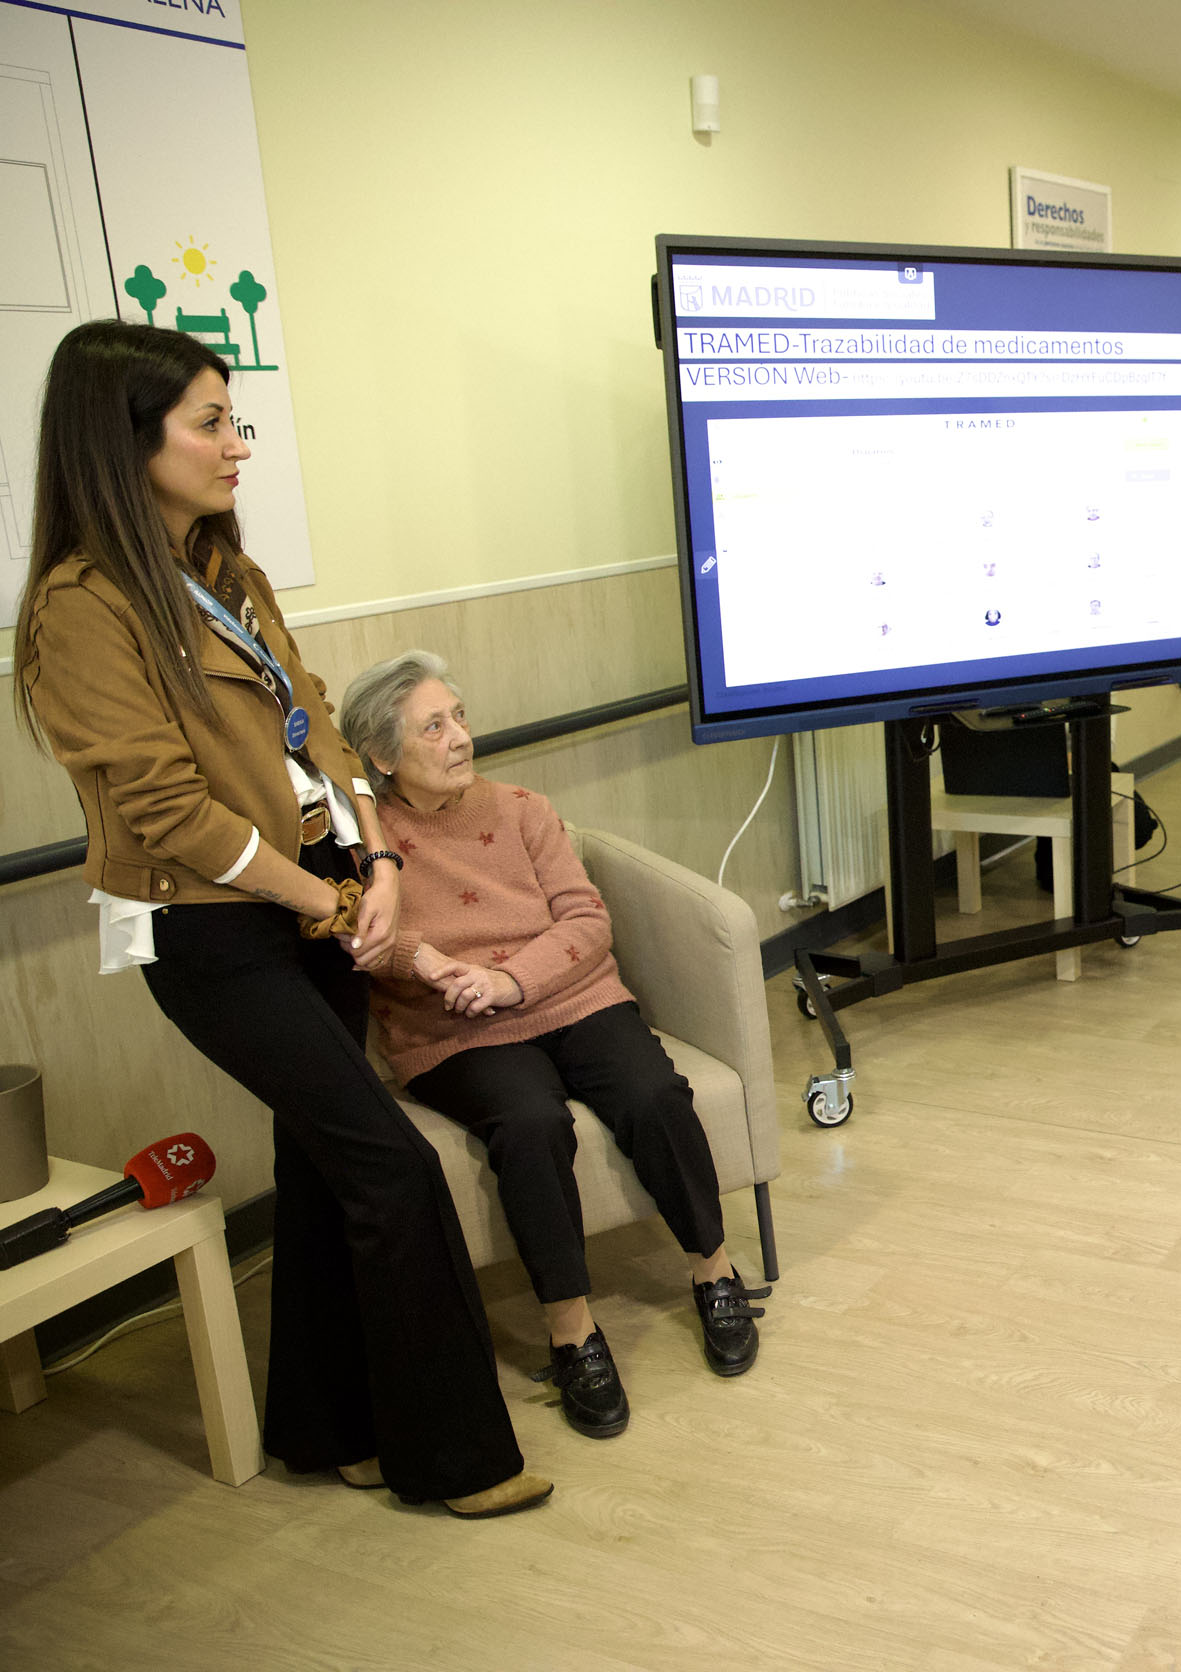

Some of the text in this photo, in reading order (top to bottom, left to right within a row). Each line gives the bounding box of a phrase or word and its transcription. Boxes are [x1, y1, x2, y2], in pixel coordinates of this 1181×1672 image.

[1026, 194, 1085, 225] Derechos
[711, 285, 816, 311] MADRID
[941, 335, 967, 354] de
[974, 337, 1124, 356] medicamentos
[944, 419, 1015, 429] TRAMED
